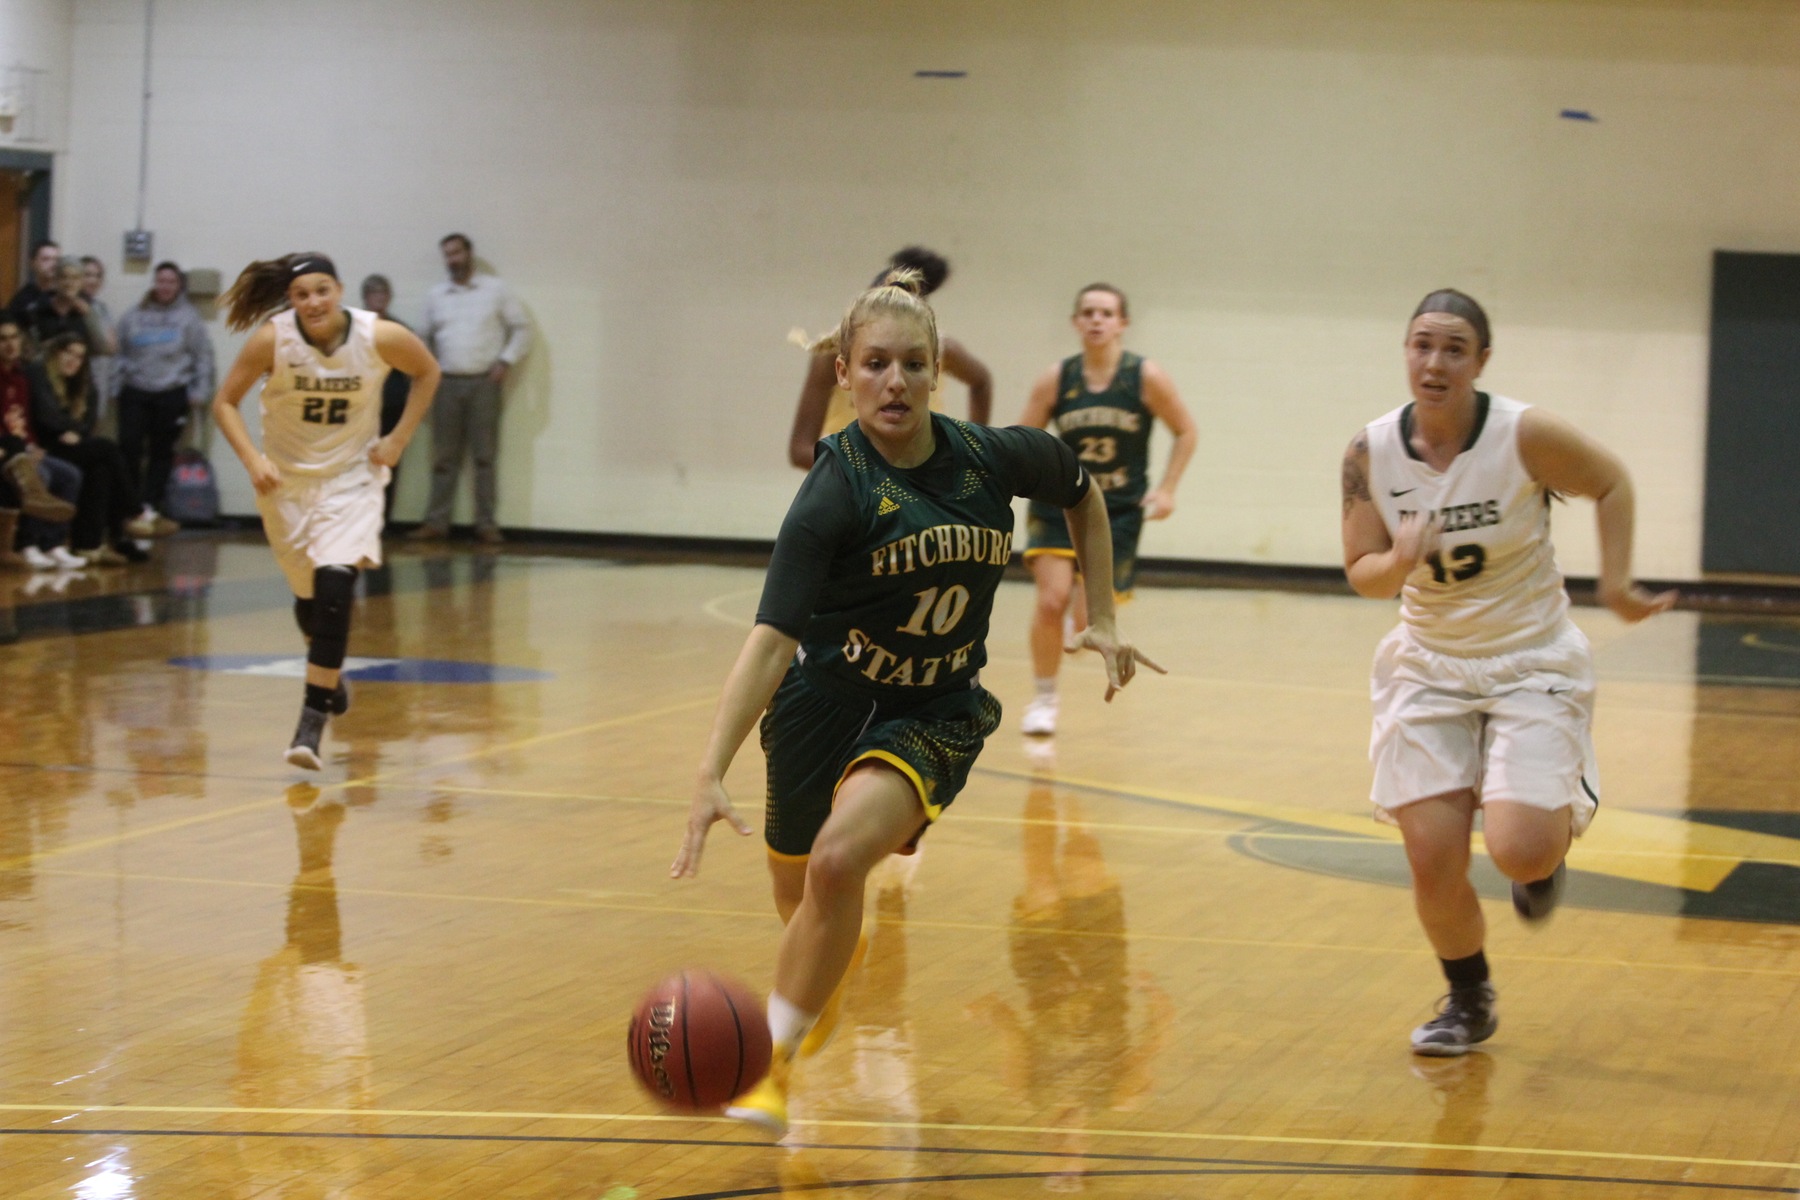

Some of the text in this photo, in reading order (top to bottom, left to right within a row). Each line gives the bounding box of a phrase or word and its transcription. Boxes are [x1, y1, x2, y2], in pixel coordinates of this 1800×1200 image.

[302, 397, 349, 425] 22
[1078, 436, 1117, 464] 23
[877, 503, 901, 516] adidas
[1397, 499, 1501, 533] ZERS
[871, 524, 1013, 576] FITCHBURG
[1425, 544, 1486, 584] 13
[895, 584, 970, 637] 10
